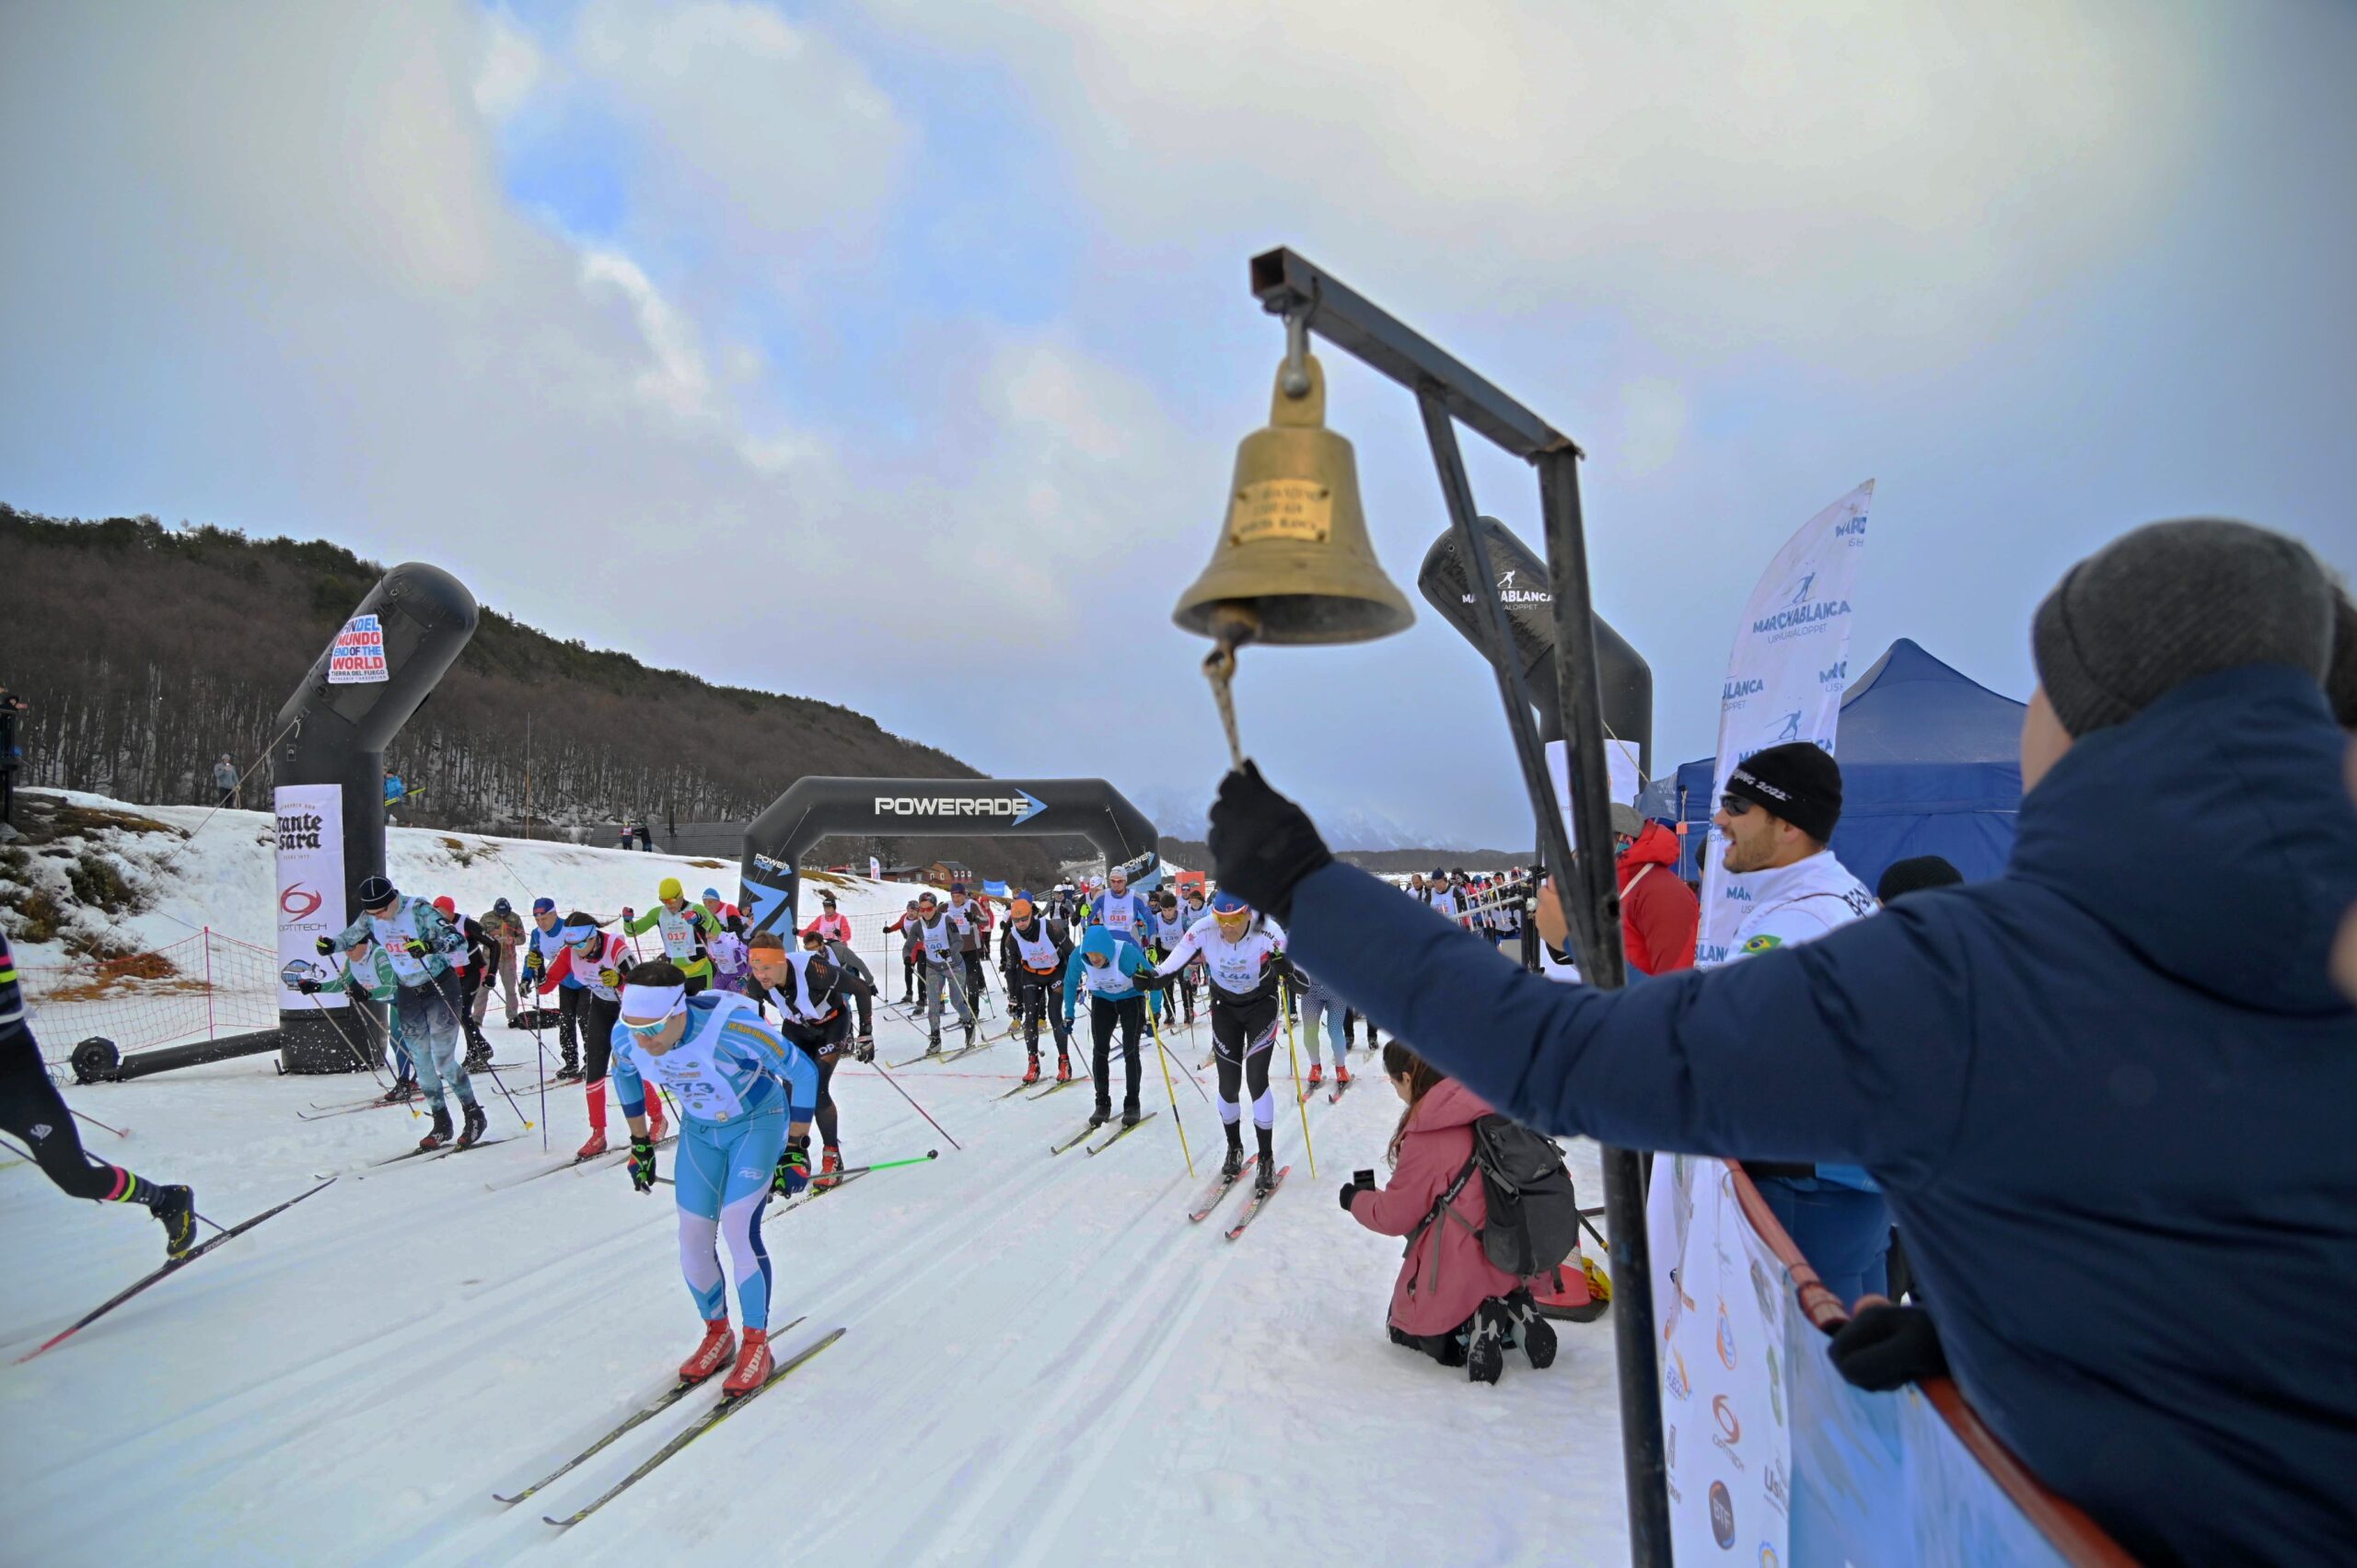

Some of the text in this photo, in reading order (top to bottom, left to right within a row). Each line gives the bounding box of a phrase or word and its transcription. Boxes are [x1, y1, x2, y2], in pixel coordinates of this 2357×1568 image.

[1753, 601, 1852, 633] MARCHABLANCA
[356, 618, 379, 632] DEL
[337, 632, 380, 646] MUNDO
[334, 646, 382, 656] END OF THE
[332, 656, 384, 670] WORLD
[1756, 781, 1788, 802] 2022
[876, 797, 1028, 816] POWERADE
[755, 853, 790, 871] POWER
[1122, 852, 1152, 868] POWER
[668, 932, 687, 941] 017
[386, 943, 409, 954] 01
[1713, 1497, 1731, 1532] BTF
